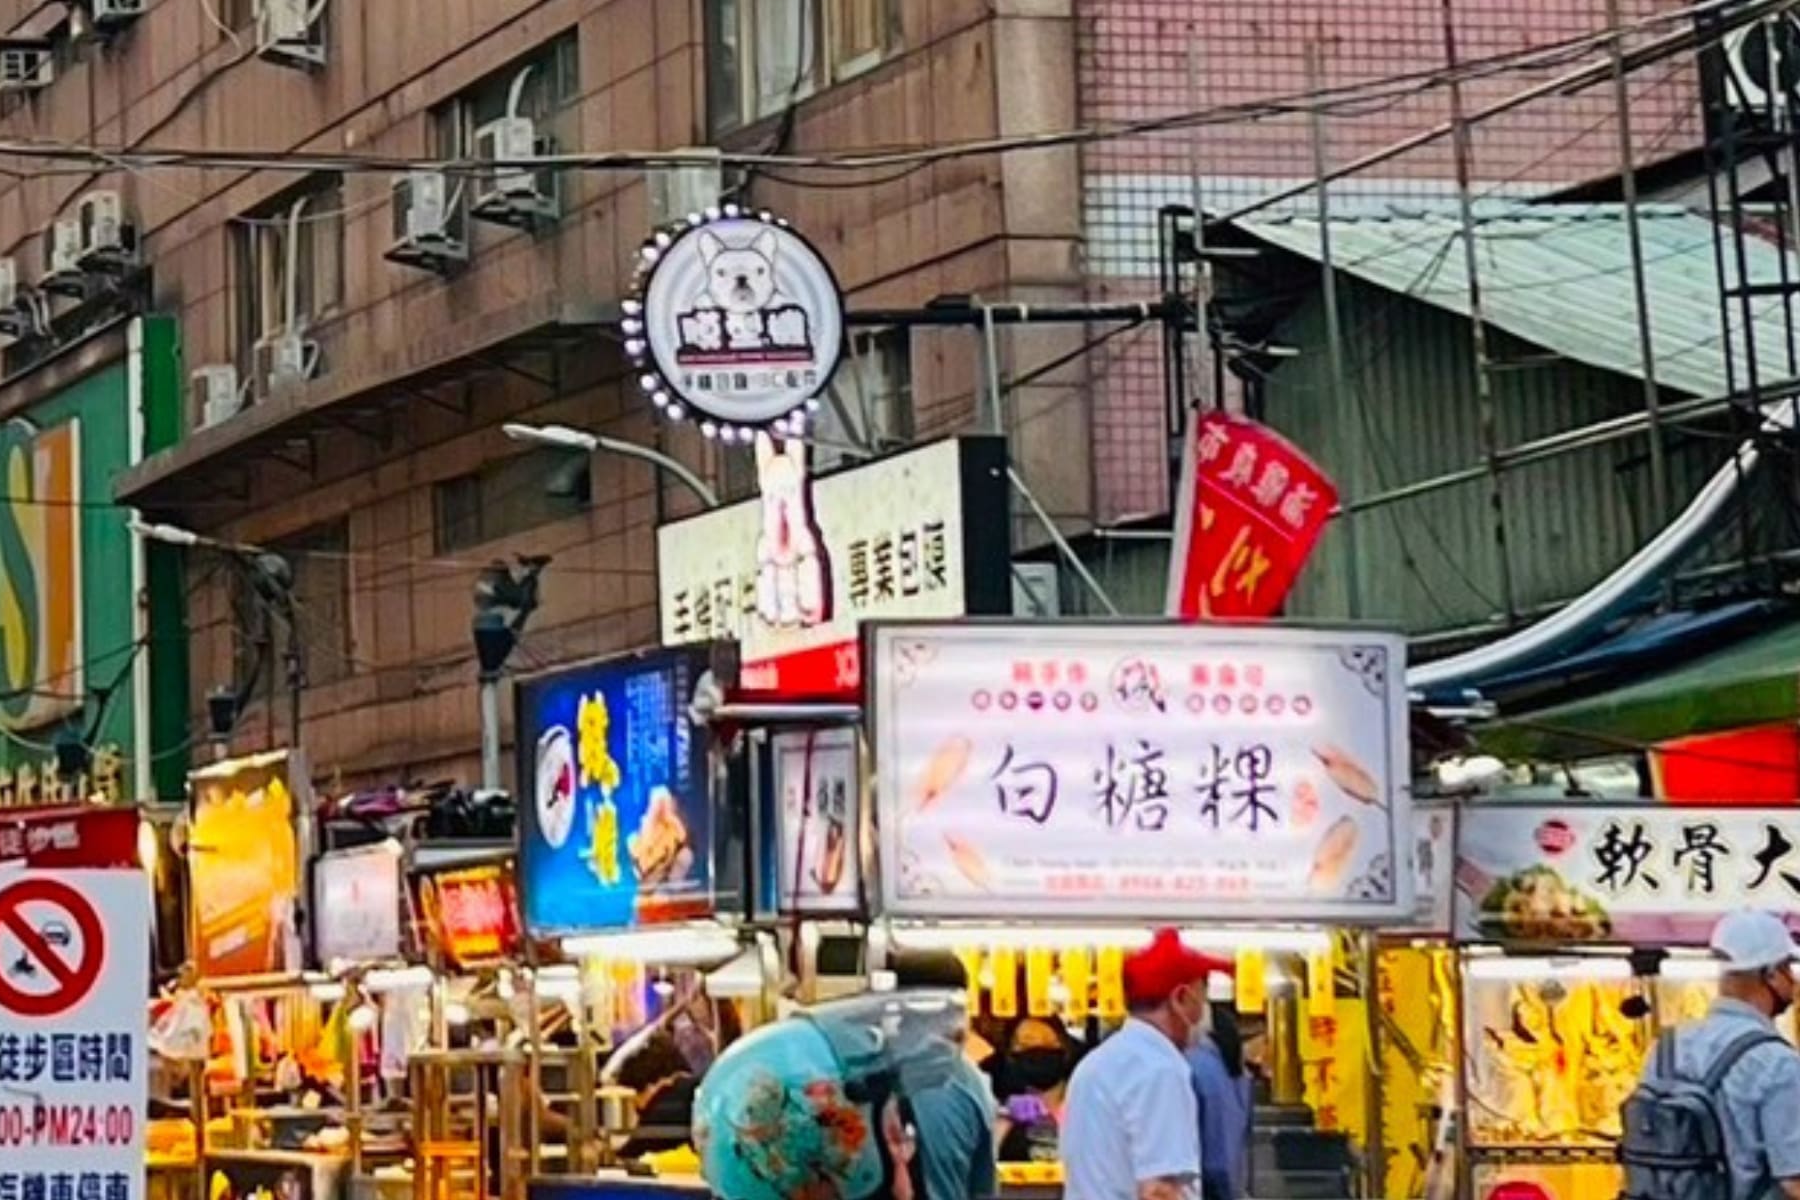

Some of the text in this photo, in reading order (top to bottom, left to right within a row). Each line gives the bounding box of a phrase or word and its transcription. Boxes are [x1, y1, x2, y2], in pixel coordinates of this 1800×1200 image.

[988, 740, 1281, 833] 白糖粿
[1594, 822, 1800, 896] 軟骨大
